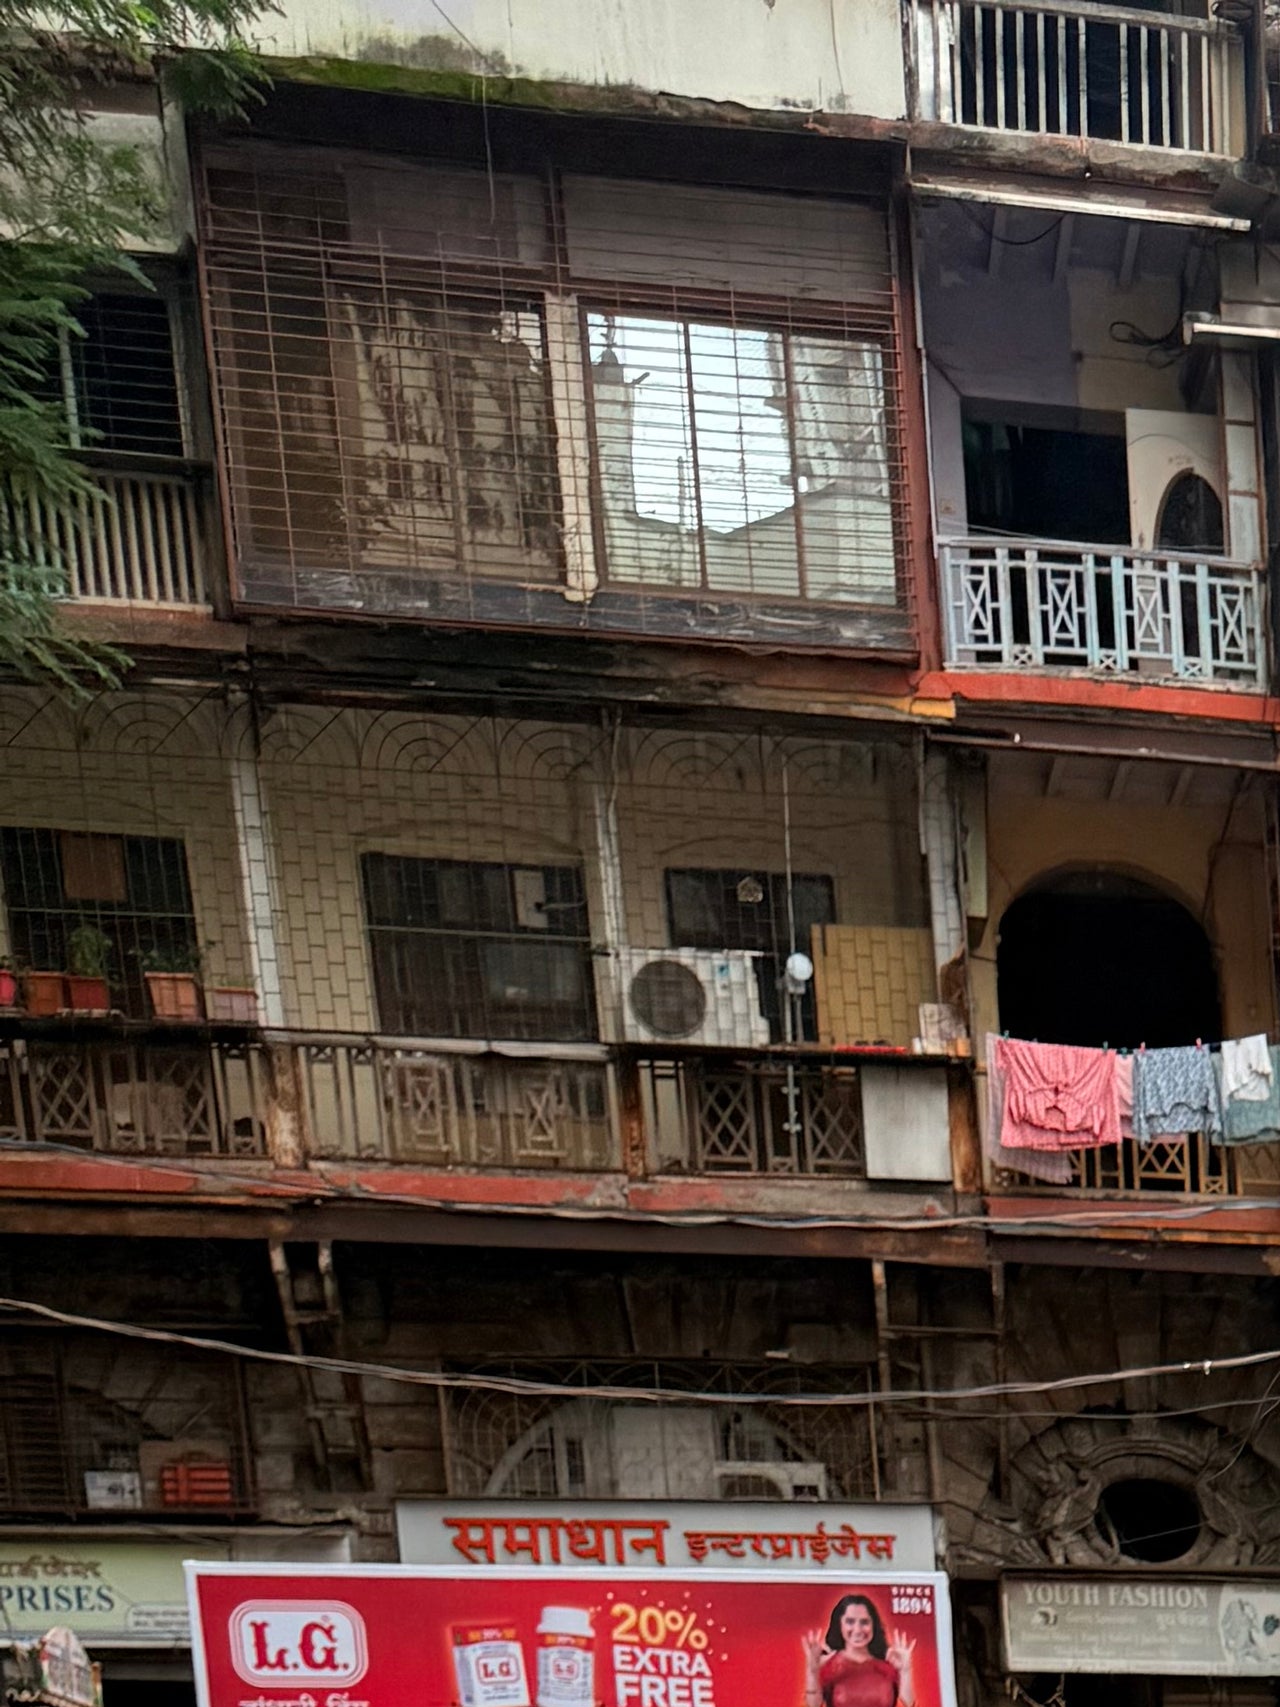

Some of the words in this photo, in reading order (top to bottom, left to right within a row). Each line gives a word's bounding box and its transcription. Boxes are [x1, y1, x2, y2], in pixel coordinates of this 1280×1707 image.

[443, 1517, 669, 1565] समाधान
[684, 1521, 895, 1565] इन्टरप्राईजेस
[892, 1597, 932, 1615] 1894
[1023, 1584, 1100, 1607] YOUTH
[1108, 1584, 1209, 1609] FASHION
[248, 1621, 350, 1671] L.G.
[610, 1603, 708, 1650] 20%
[613, 1644, 713, 1677] EXTRA
